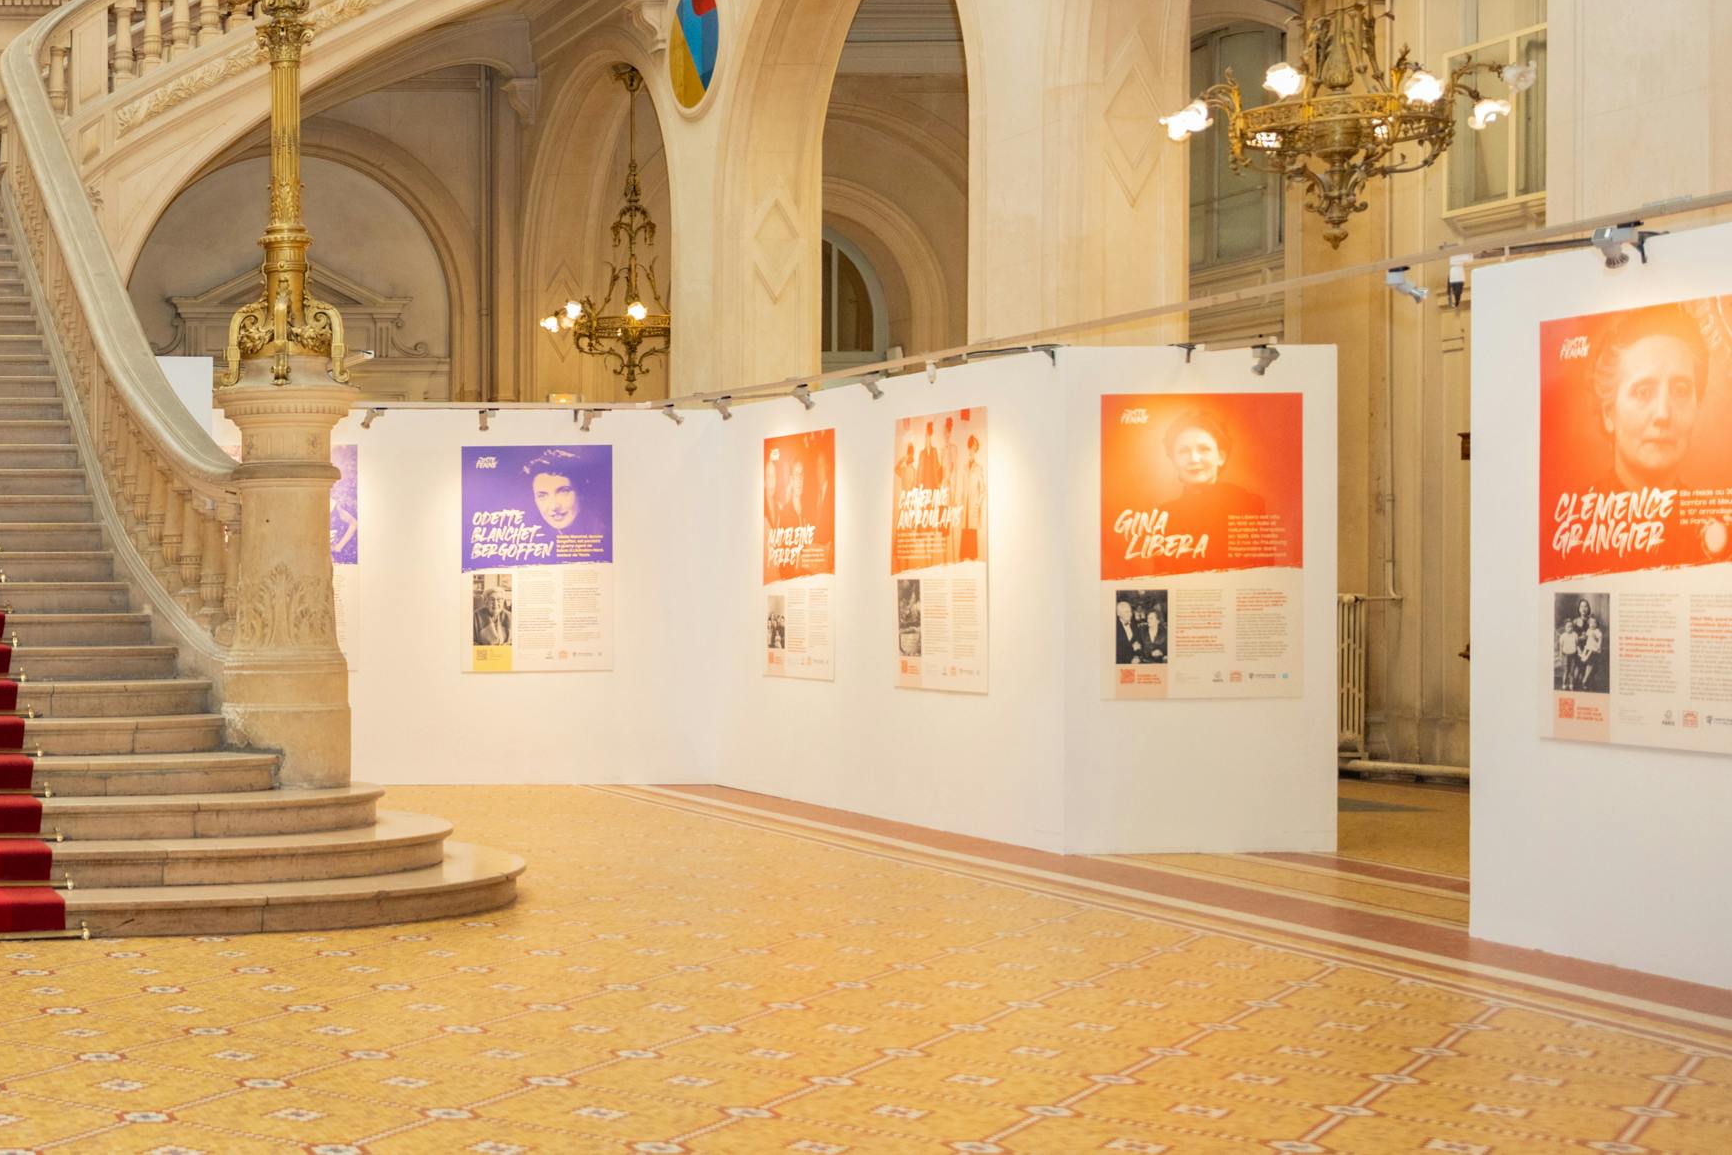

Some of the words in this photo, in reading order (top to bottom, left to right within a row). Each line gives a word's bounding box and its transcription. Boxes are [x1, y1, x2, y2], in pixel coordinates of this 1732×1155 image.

[472, 508, 525, 527] ODETTE
[1554, 486, 1677, 524] CLÉMENCE
[470, 523, 545, 544] BLANCHET-
[1113, 508, 1169, 541] GINA
[470, 541, 555, 560] BERGOFFEN
[1124, 533, 1210, 560] LIBERA
[1552, 520, 1665, 560] GRANGIER
